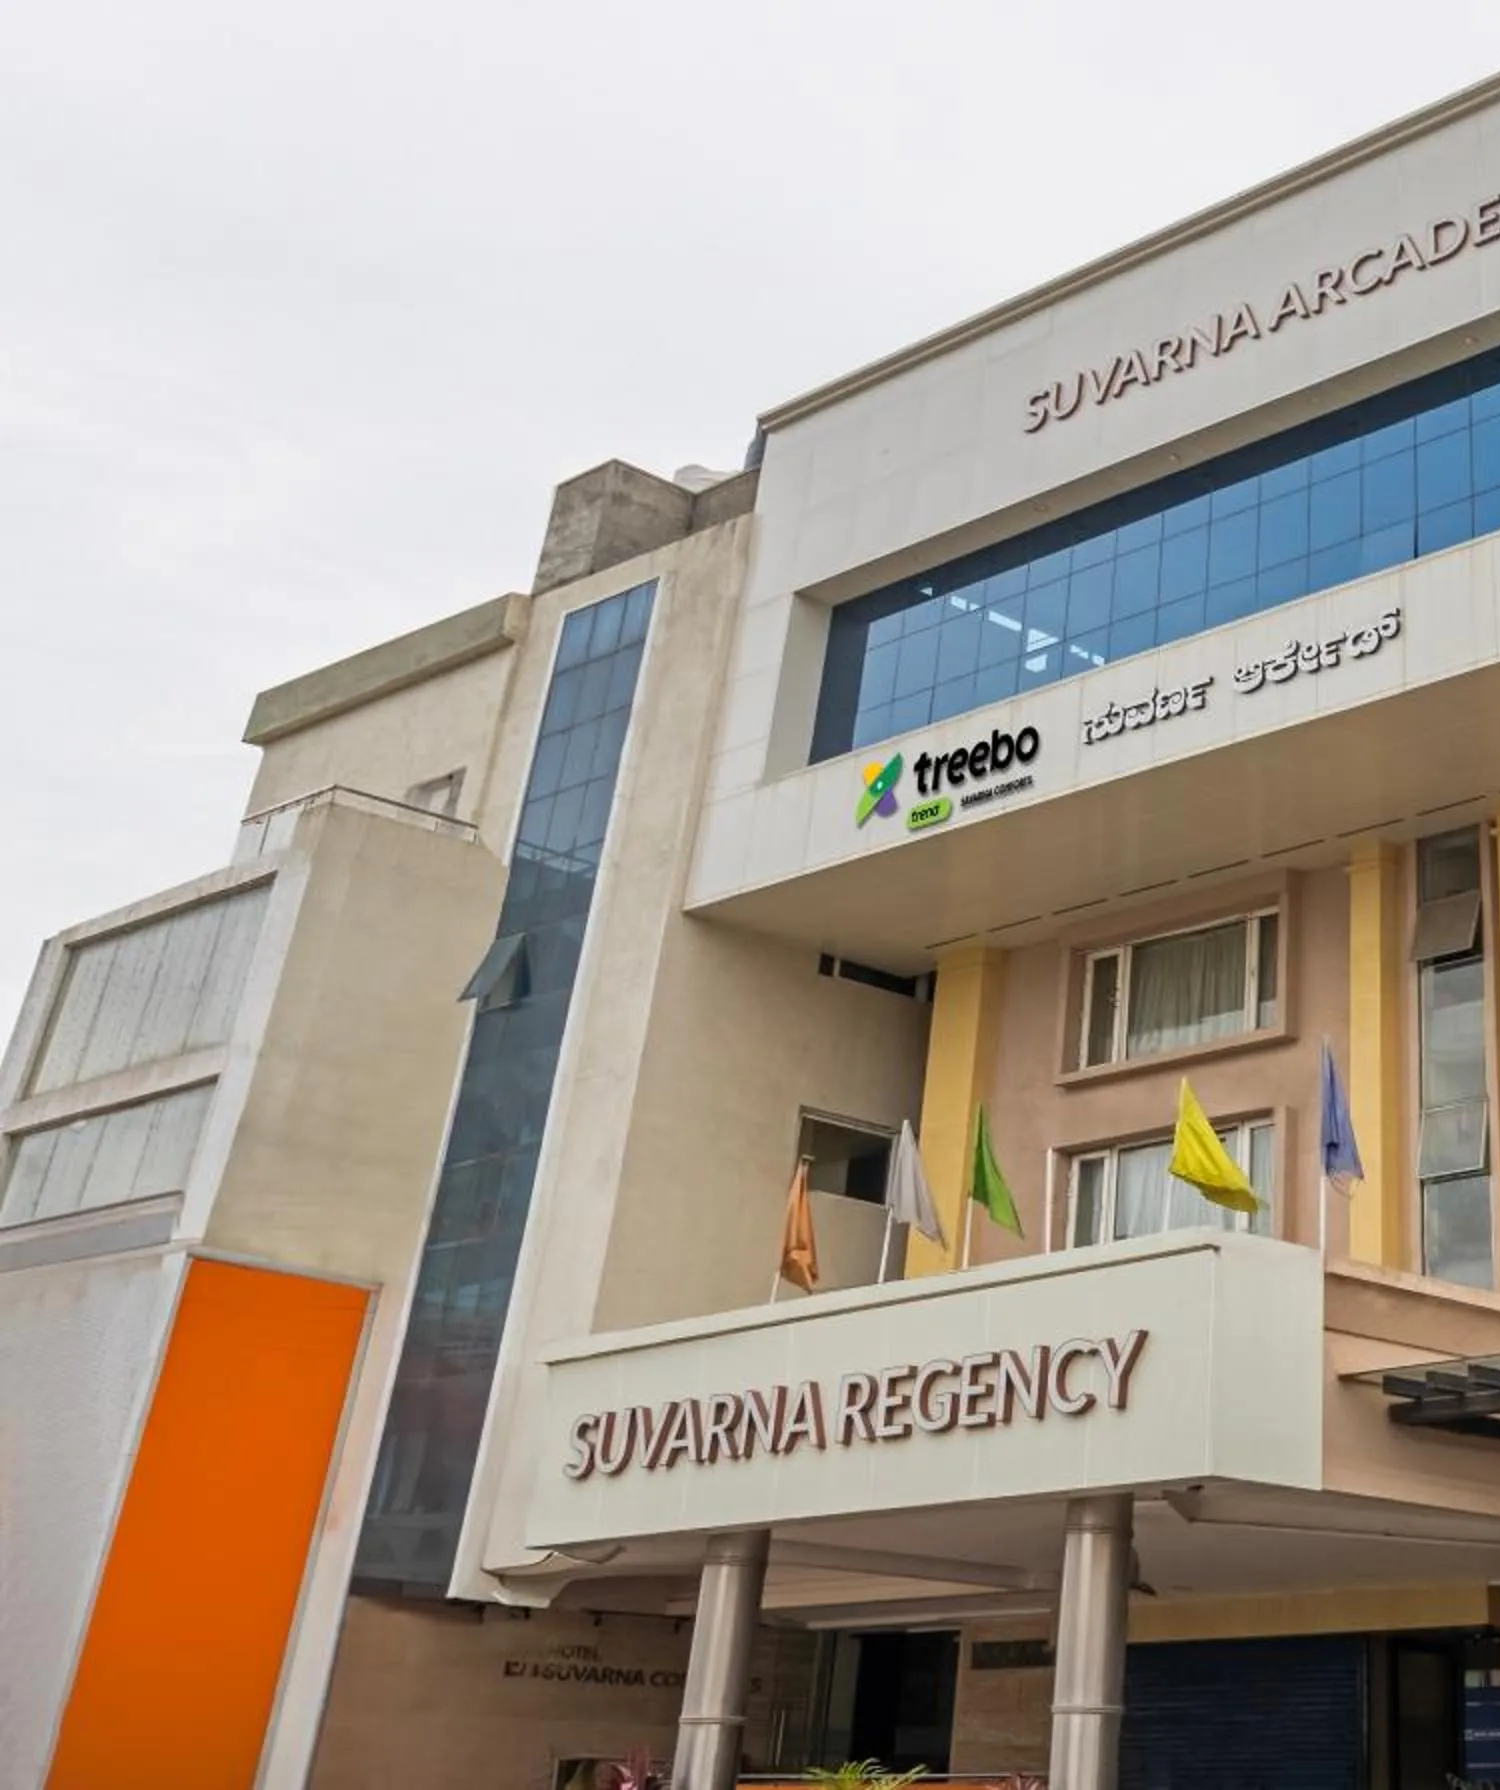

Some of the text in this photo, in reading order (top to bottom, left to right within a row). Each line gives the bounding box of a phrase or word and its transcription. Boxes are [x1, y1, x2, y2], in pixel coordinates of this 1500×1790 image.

[1023, 302, 1261, 434] SUVARNA
[913, 724, 1040, 795] treebo
[562, 1328, 1149, 1480] SUVARNA REGENCY
[542, 1663, 645, 1687] SUVARNA
